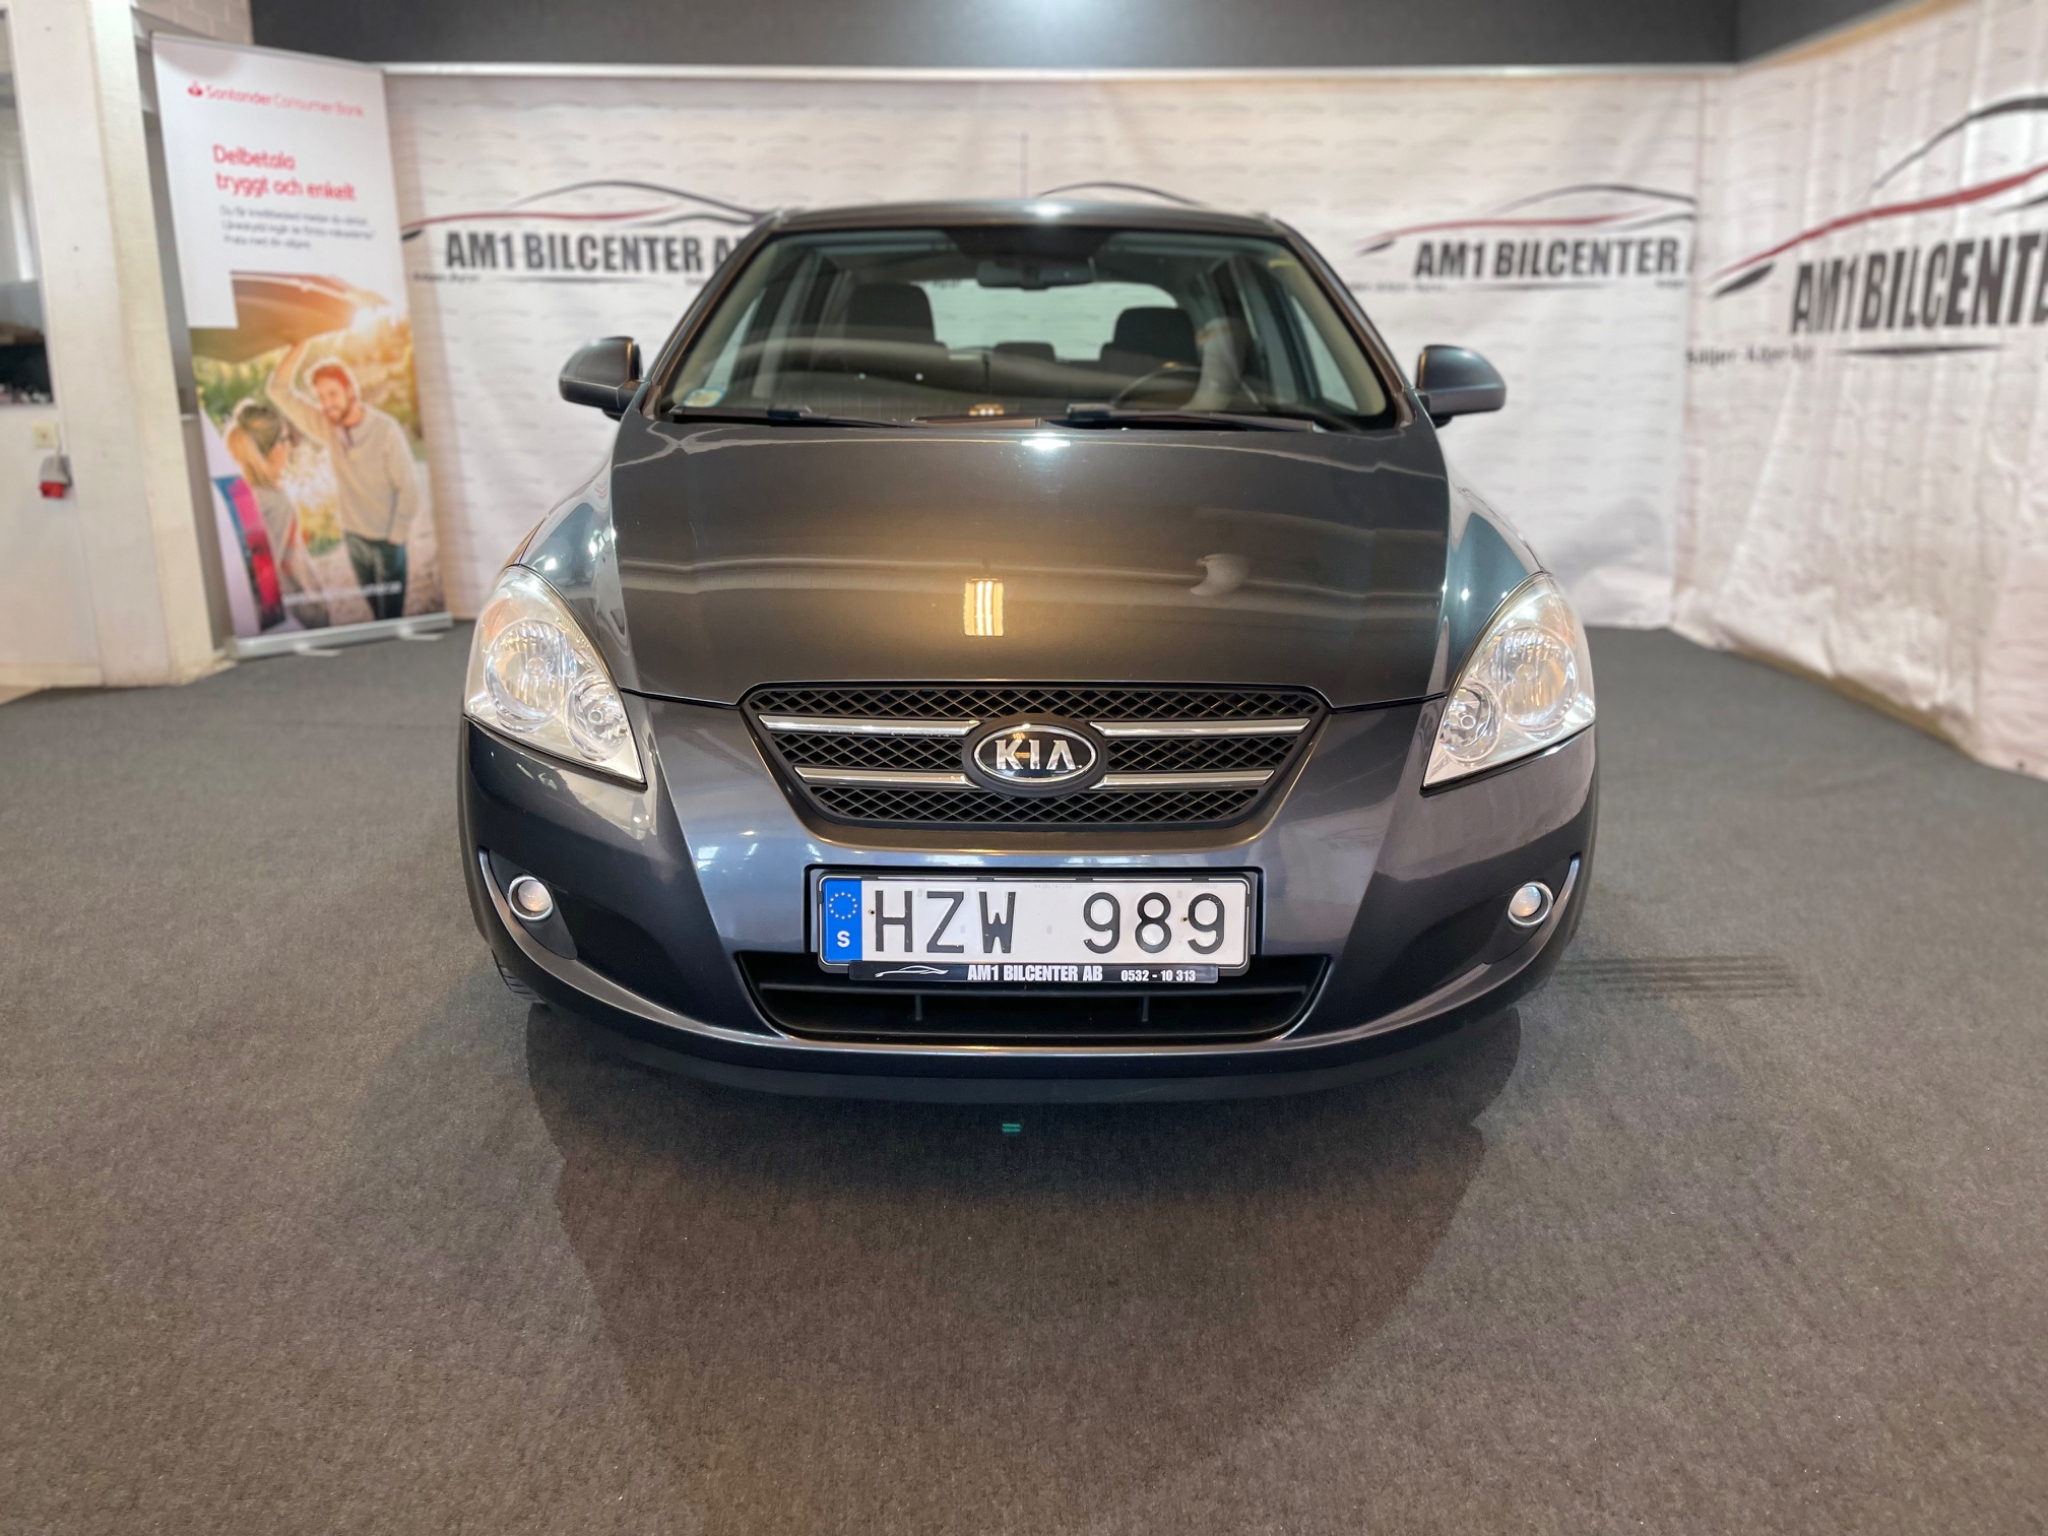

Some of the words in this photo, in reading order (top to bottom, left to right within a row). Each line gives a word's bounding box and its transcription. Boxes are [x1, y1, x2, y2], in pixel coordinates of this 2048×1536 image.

[212, 144, 296, 171] Delbetala
[215, 172, 269, 198] tryggt
[273, 178, 303, 197] och
[305, 181, 357, 202] enkelt
[445, 231, 515, 271] AM1
[522, 232, 703, 273] BILCENTER
[1414, 239, 1486, 279] AM1
[1493, 236, 1680, 278] BILCENTER
[1790, 253, 1860, 335] AM1
[994, 739, 1077, 770] KIA
[836, 930, 850, 948] S
[874, 891, 1016, 954] HZW
[1083, 891, 1226, 954] 989
[966, 965, 999, 982] AM1
[1003, 965, 1079, 982] BILCENTER
[1082, 965, 1104, 982] AB
[1120, 971, 1149, 982] 0532
[1161, 970, 1174, 982] 10
[1176, 970, 1196, 982] 313
